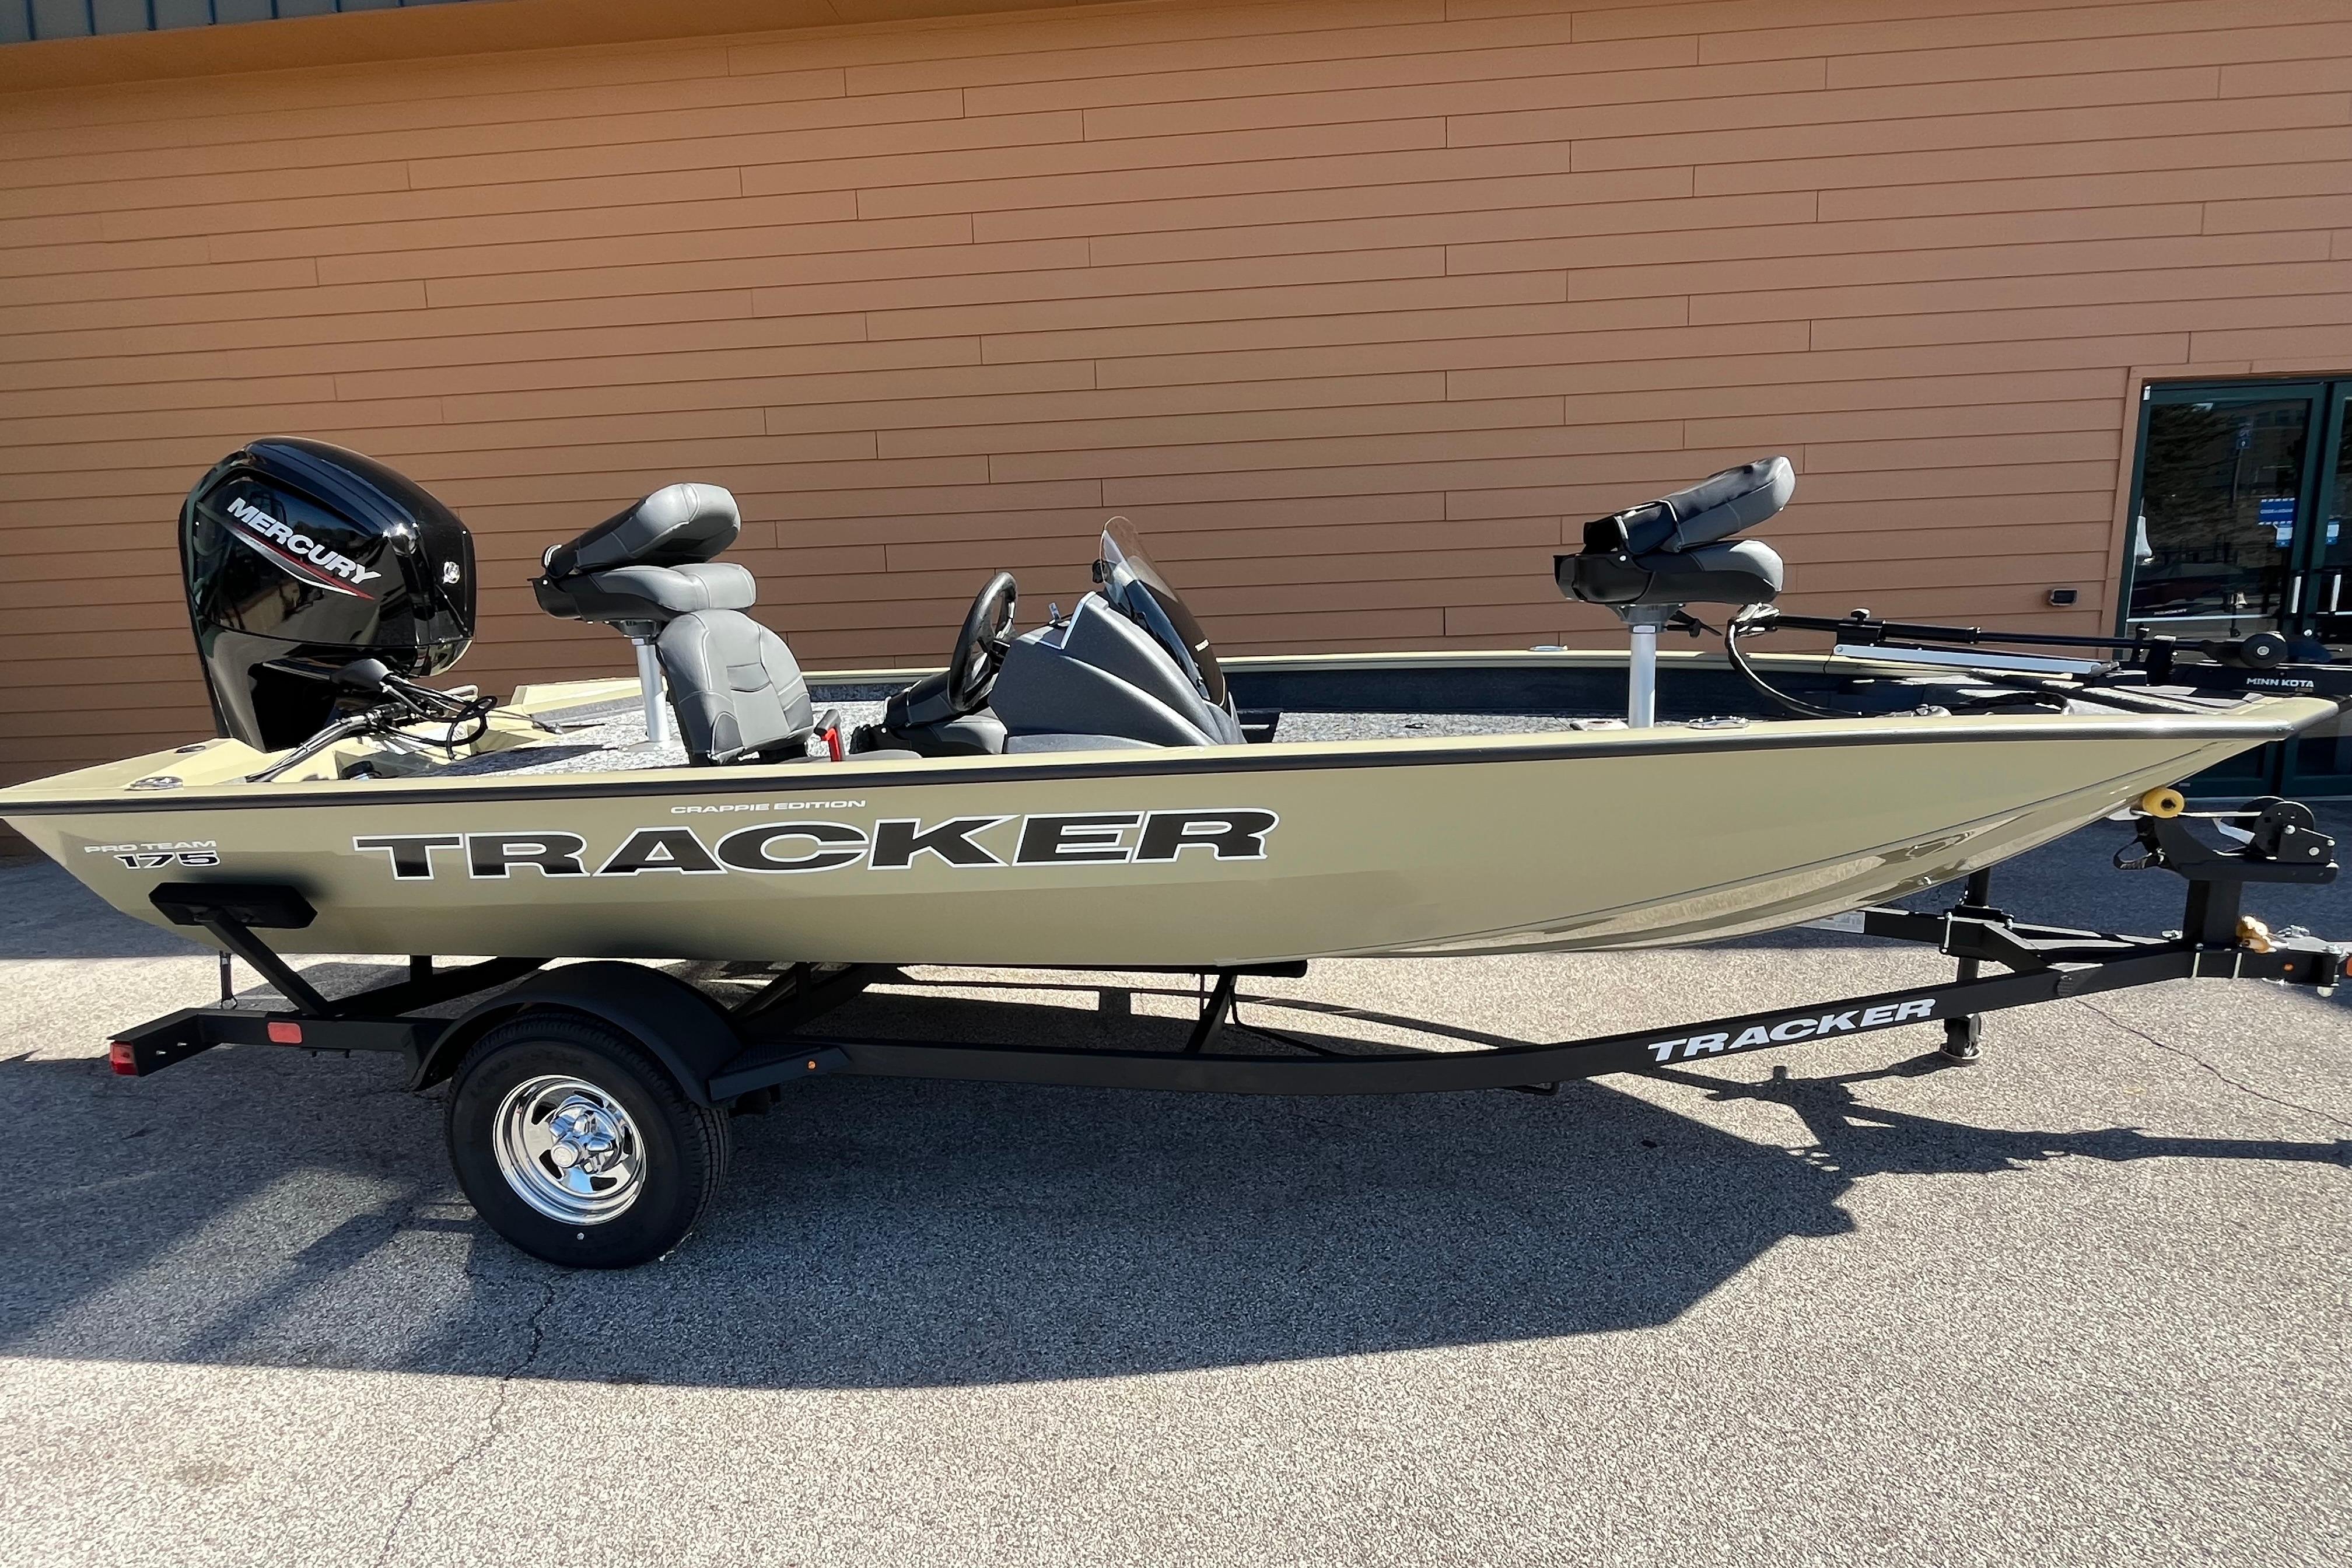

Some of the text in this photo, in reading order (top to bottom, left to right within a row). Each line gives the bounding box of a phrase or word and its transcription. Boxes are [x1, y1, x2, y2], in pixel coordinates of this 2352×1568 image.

[227, 497, 382, 584] MERCURY
[2246, 678, 2314, 687] MINN KOTA
[671, 800, 866, 814] CRAPPIE EDITION
[84, 840, 217, 853] PRO TEAM
[352, 807, 1280, 881] TRACKER
[113, 850, 220, 869] 175
[1647, 998, 1937, 1062] TRACKER
